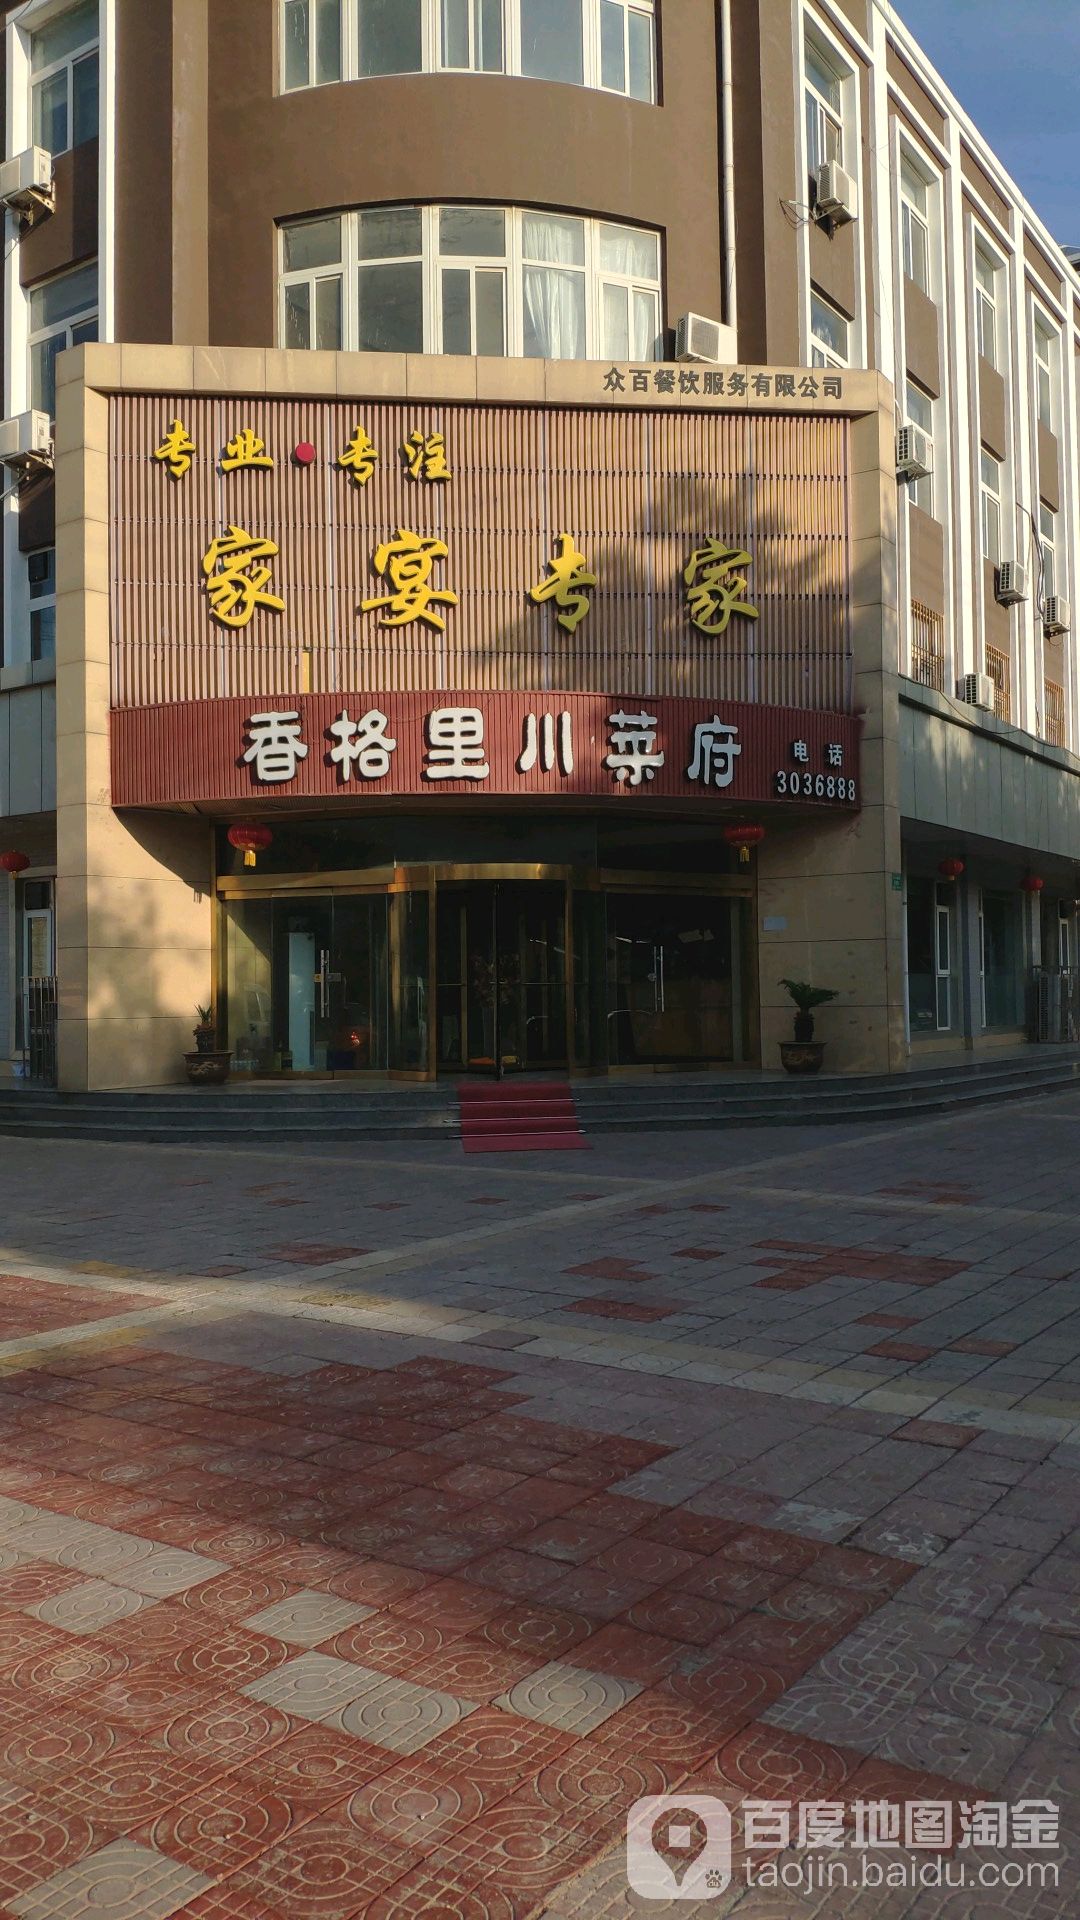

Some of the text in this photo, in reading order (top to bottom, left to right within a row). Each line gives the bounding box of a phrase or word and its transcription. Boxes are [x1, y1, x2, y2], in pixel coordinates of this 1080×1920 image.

[603, 367, 842, 399] 众百餐饮服务有限公司
[203, 525, 760, 635] 家宴专家
[243, 706, 742, 788] 香格里川菜府
[794, 740, 843, 766] 电话
[777, 770, 856, 801] 3036888
